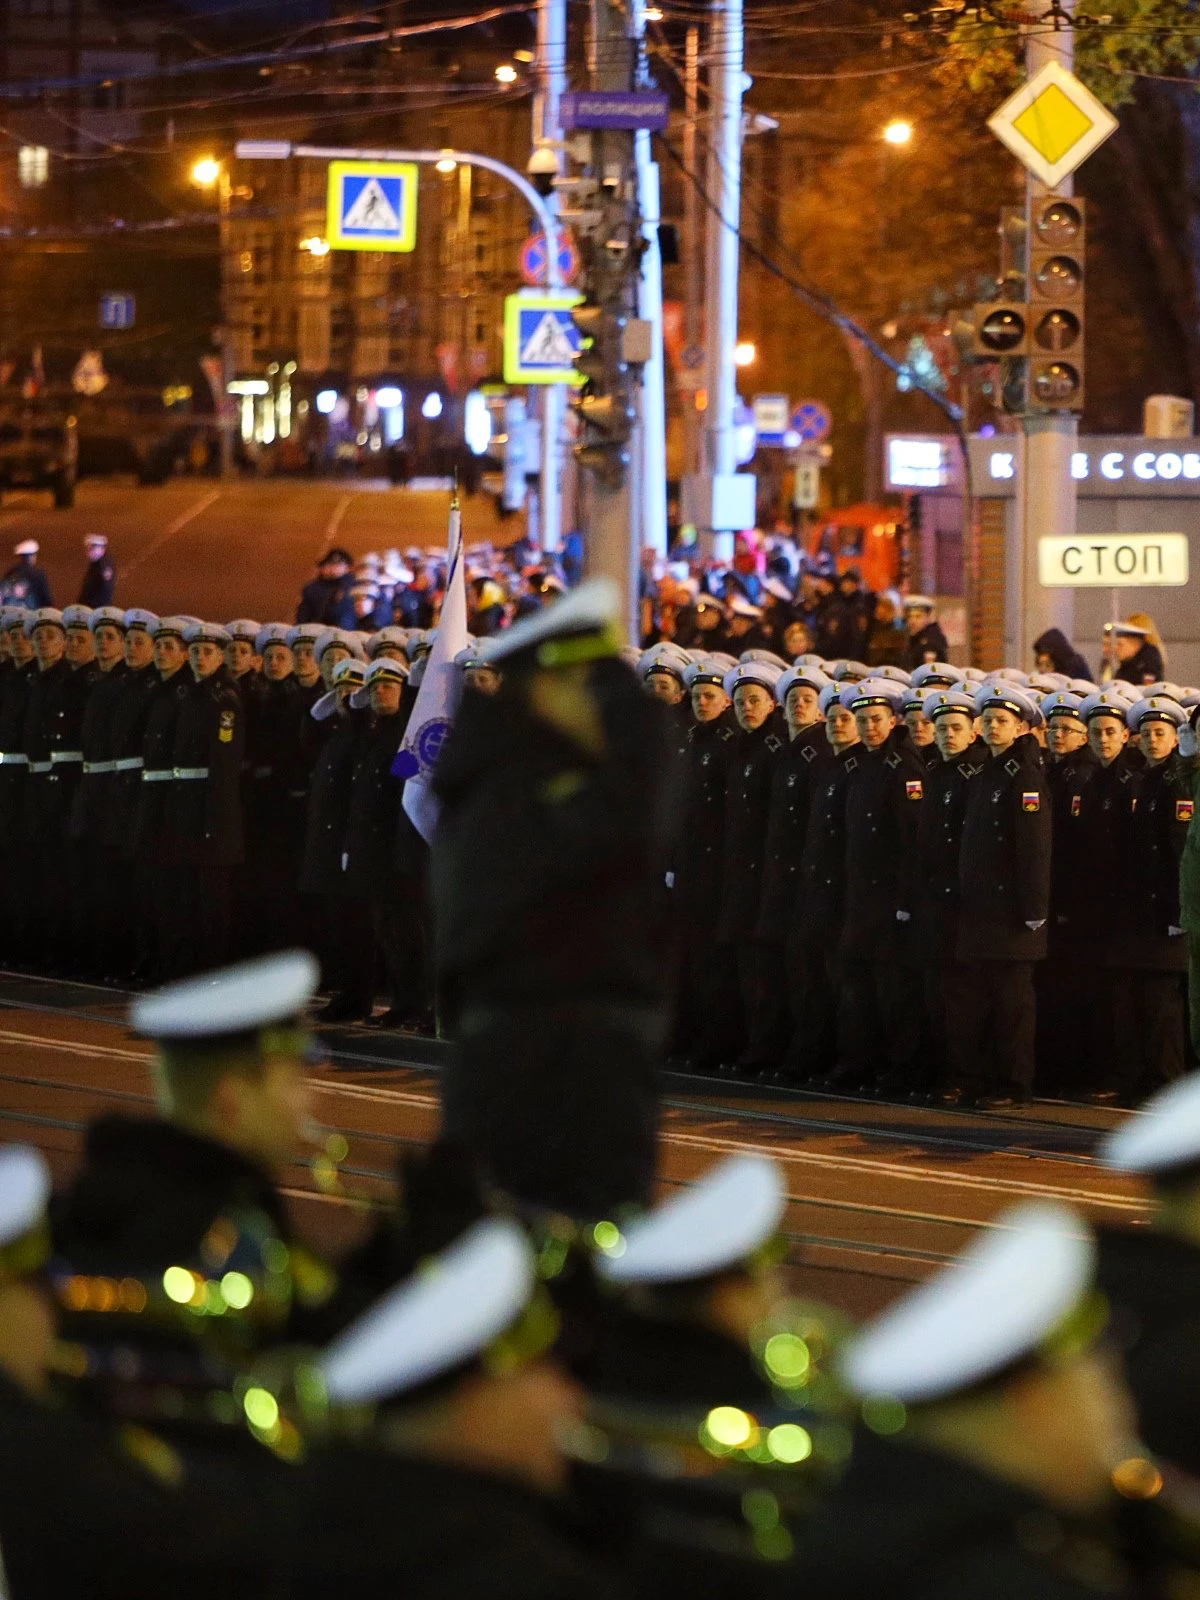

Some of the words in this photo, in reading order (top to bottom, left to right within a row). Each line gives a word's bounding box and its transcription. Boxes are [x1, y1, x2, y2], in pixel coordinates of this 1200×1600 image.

[990, 452, 1089, 479] КЕ
[1101, 452, 1124, 479] С
[1062, 545, 1164, 575] СТОП
